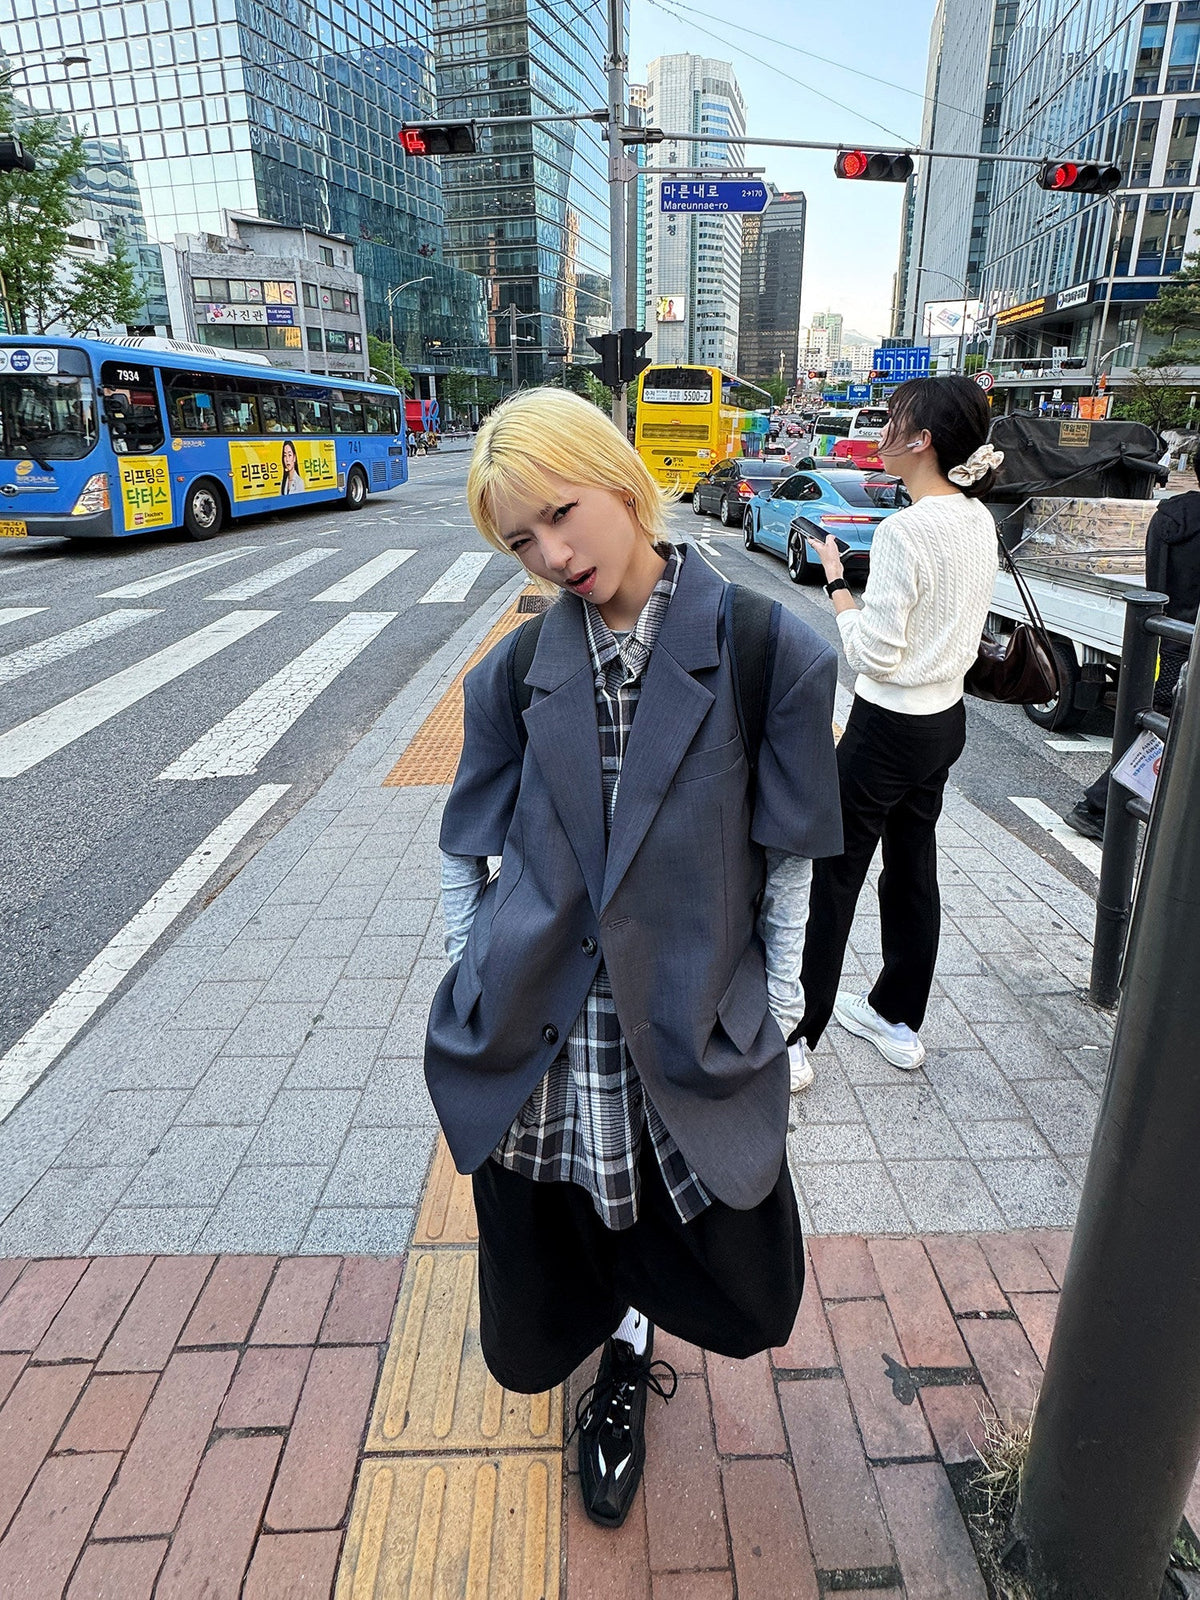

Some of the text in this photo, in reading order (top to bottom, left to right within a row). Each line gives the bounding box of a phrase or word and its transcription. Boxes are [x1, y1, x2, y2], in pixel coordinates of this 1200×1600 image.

[663, 184, 719, 199] 마른내로
[663, 201, 729, 210] Mareunnae-ro
[226, 309, 264, 322] 사진관
[116, 369, 140, 382] 7934
[978, 377, 990, 387] 50
[683, 390, 708, 401] 5500-2
[348, 441, 362, 453] 741
[241, 462, 279, 482] 리프팅은
[304, 458, 330, 476] 닥터스
[124, 468, 165, 485] 리프팅은
[126, 486, 168, 508] 닥터스
[3, 527, 26, 536] 7934
